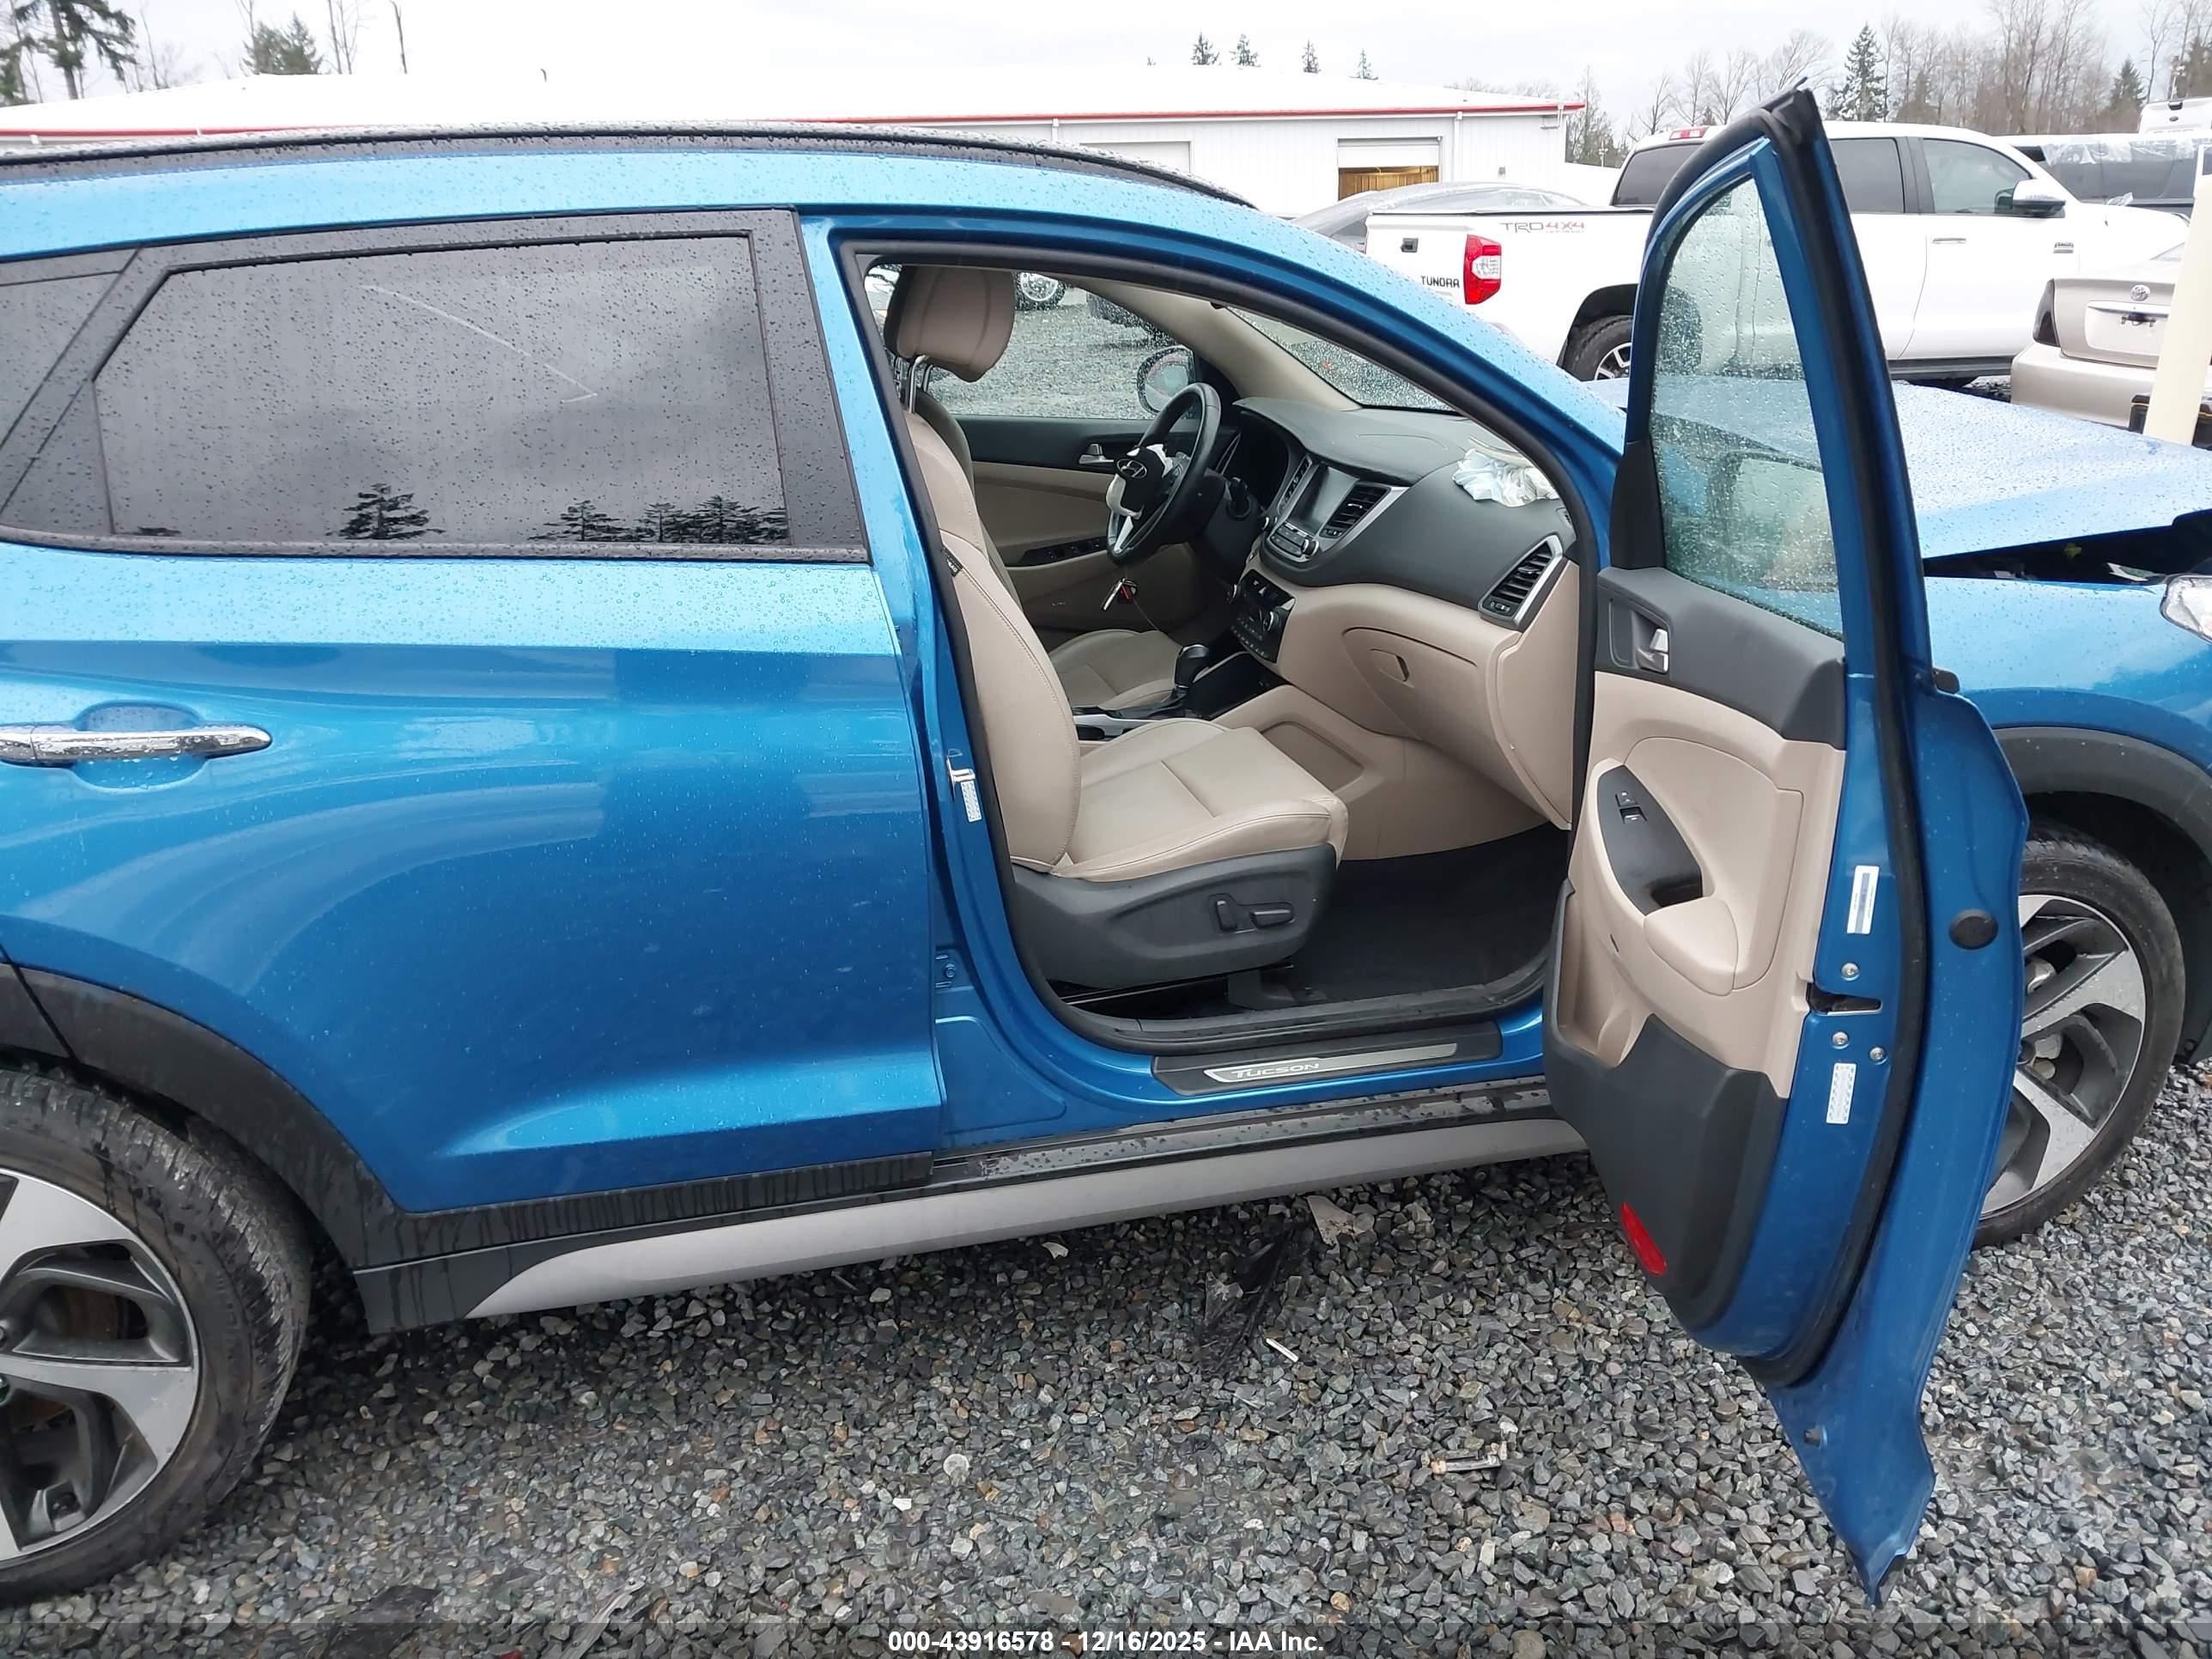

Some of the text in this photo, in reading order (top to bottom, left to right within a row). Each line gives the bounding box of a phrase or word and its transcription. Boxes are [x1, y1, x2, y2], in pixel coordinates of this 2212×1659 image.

[1500, 222, 1544, 234] TRD
[1420, 275, 1461, 289] TUNDRA
[1231, 1062, 1321, 1079] TUCSON
